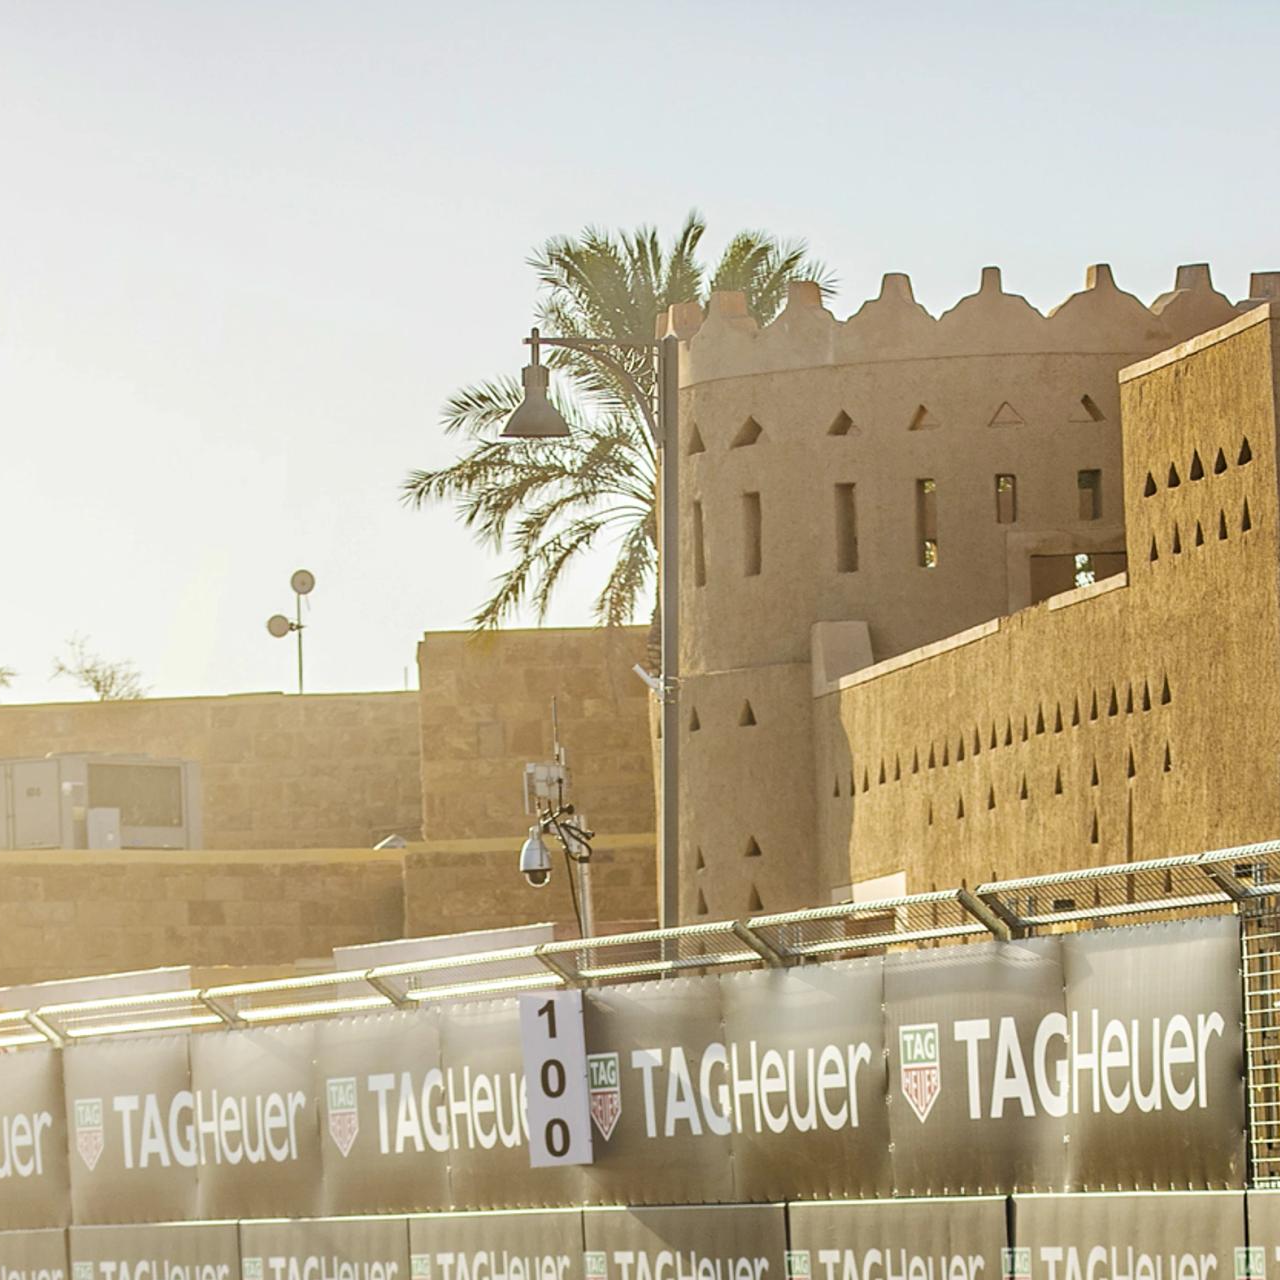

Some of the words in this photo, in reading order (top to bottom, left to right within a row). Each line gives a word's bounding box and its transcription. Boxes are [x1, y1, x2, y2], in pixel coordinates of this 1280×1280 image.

[903, 1031, 936, 1061] TAG
[590, 1060, 618, 1087] TAG
[904, 1069, 939, 1115] HEUER
